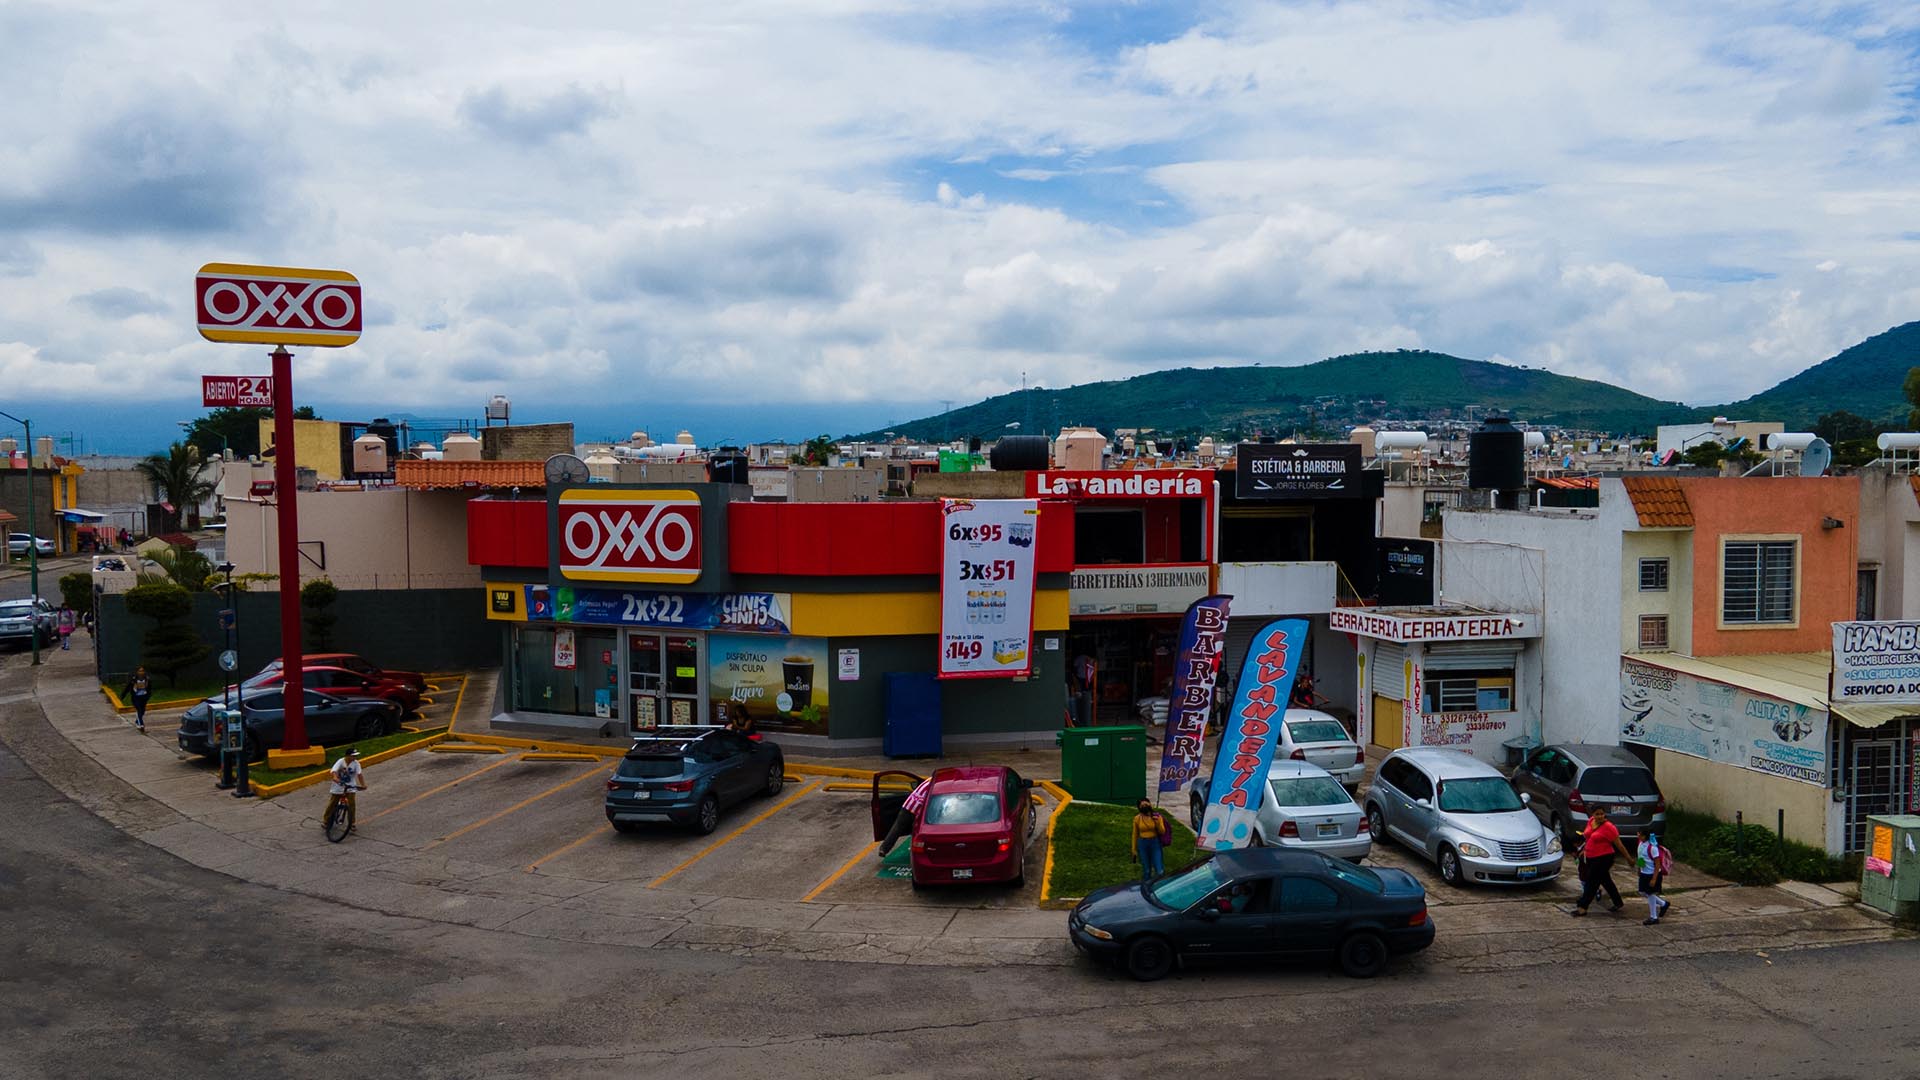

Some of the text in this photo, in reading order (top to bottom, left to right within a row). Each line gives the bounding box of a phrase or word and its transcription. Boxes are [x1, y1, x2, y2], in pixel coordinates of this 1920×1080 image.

[204, 281, 355, 328] OXXO
[206, 381, 236, 400] ABIERTO
[239, 378, 270, 397] 24
[239, 397, 271, 405] HORAS
[1252, 457, 1346, 474] ESTÉTICA & BARBERIA
[1274, 481, 1297, 490] JORGE
[565, 510, 693, 562] OXXO
[949, 523, 1002, 542] 6x$95
[959, 559, 1015, 581] 3x$51
[1071, 571, 1143, 590] ERRETERÍAS
[622, 593, 684, 623] 2x$22
[722, 595, 767, 613] CLINK
[1330, 611, 1399, 639] CERRAJERIA
[1402, 618, 1512, 639] CERRAJERIA
[726, 651, 767, 662] DISFRÚTALO
[946, 641, 982, 660] $149
[1851, 653, 1920, 666] HAMBURGUESA
[729, 663, 765, 673] SIN CULPA
[1624, 663, 1678, 682] HAMBURGUESAS
[730, 680, 764, 704] Ligero
[1171, 605, 1225, 760] BARBER
[1844, 684, 1895, 696] SERVICIO
[1897, 683, 1905, 694] A
[1220, 630, 1288, 808] LAVANDERIA
[1745, 698, 1790, 721] ALITAS
[1421, 715, 1436, 725] TEL
[1751, 756, 1784, 775] BIONICOS
